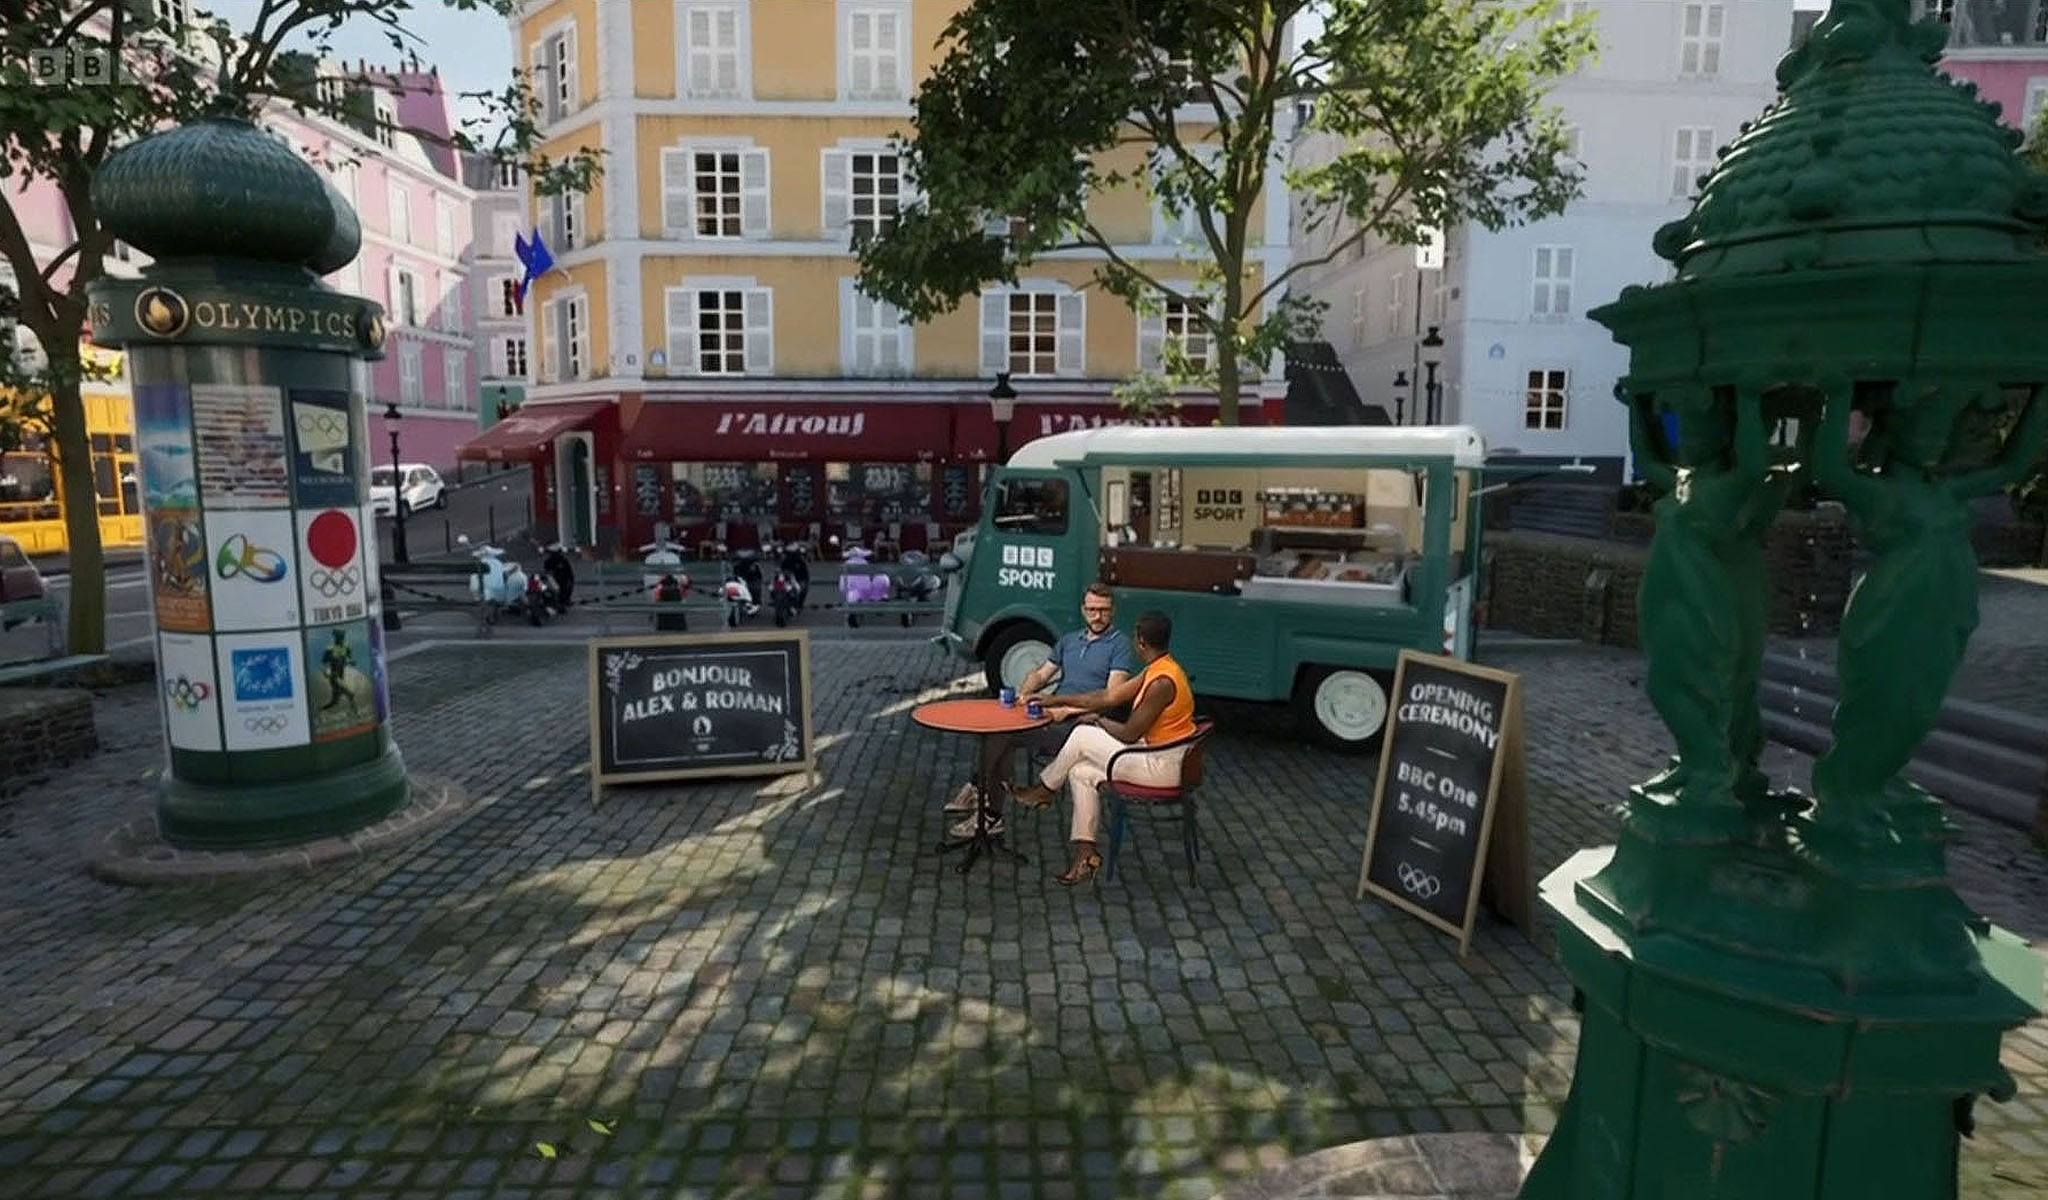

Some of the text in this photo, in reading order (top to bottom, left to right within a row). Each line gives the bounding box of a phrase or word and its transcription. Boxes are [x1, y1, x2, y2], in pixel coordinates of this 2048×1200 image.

[194, 301, 356, 339] OLYMPICS
[1197, 489, 1243, 505] BBC
[1194, 507, 1246, 522] SPORT
[1003, 544, 1054, 569] BBC
[998, 567, 1057, 591] SPORT
[651, 665, 752, 693] BONJOUR
[623, 690, 783, 723] ALEX & ROMAN
[1410, 682, 1494, 724] OPENING
[1398, 702, 1499, 750] CEREMONY
[1397, 760, 1479, 809] BBC One
[1397, 791, 1467, 837] 5.45pm
